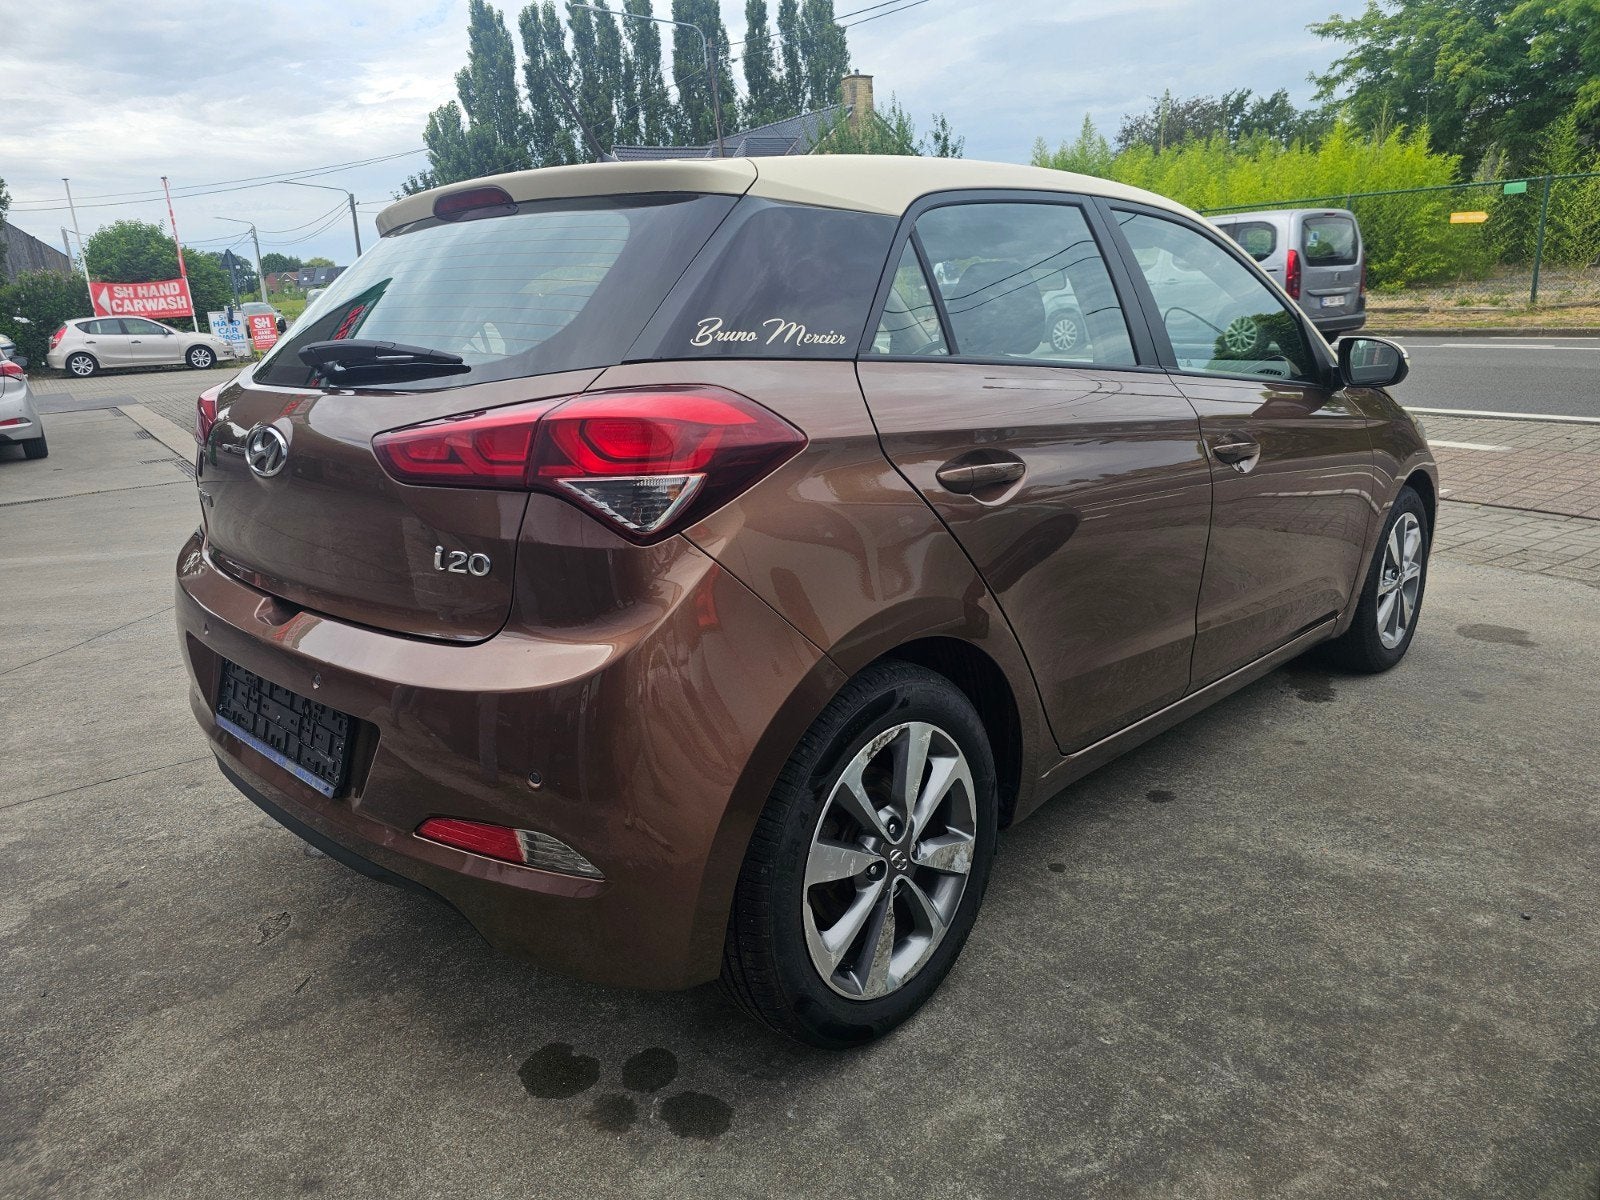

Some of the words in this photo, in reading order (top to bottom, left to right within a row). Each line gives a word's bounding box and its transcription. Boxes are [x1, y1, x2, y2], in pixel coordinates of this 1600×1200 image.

[113, 286, 134, 298] SH
[137, 282, 180, 297] HAND
[112, 295, 188, 312] CARWASH
[253, 316, 271, 329] SH
[690, 317, 758, 347] Bruno
[763, 318, 846, 347] Mercier
[433, 545, 491, 577] i20
